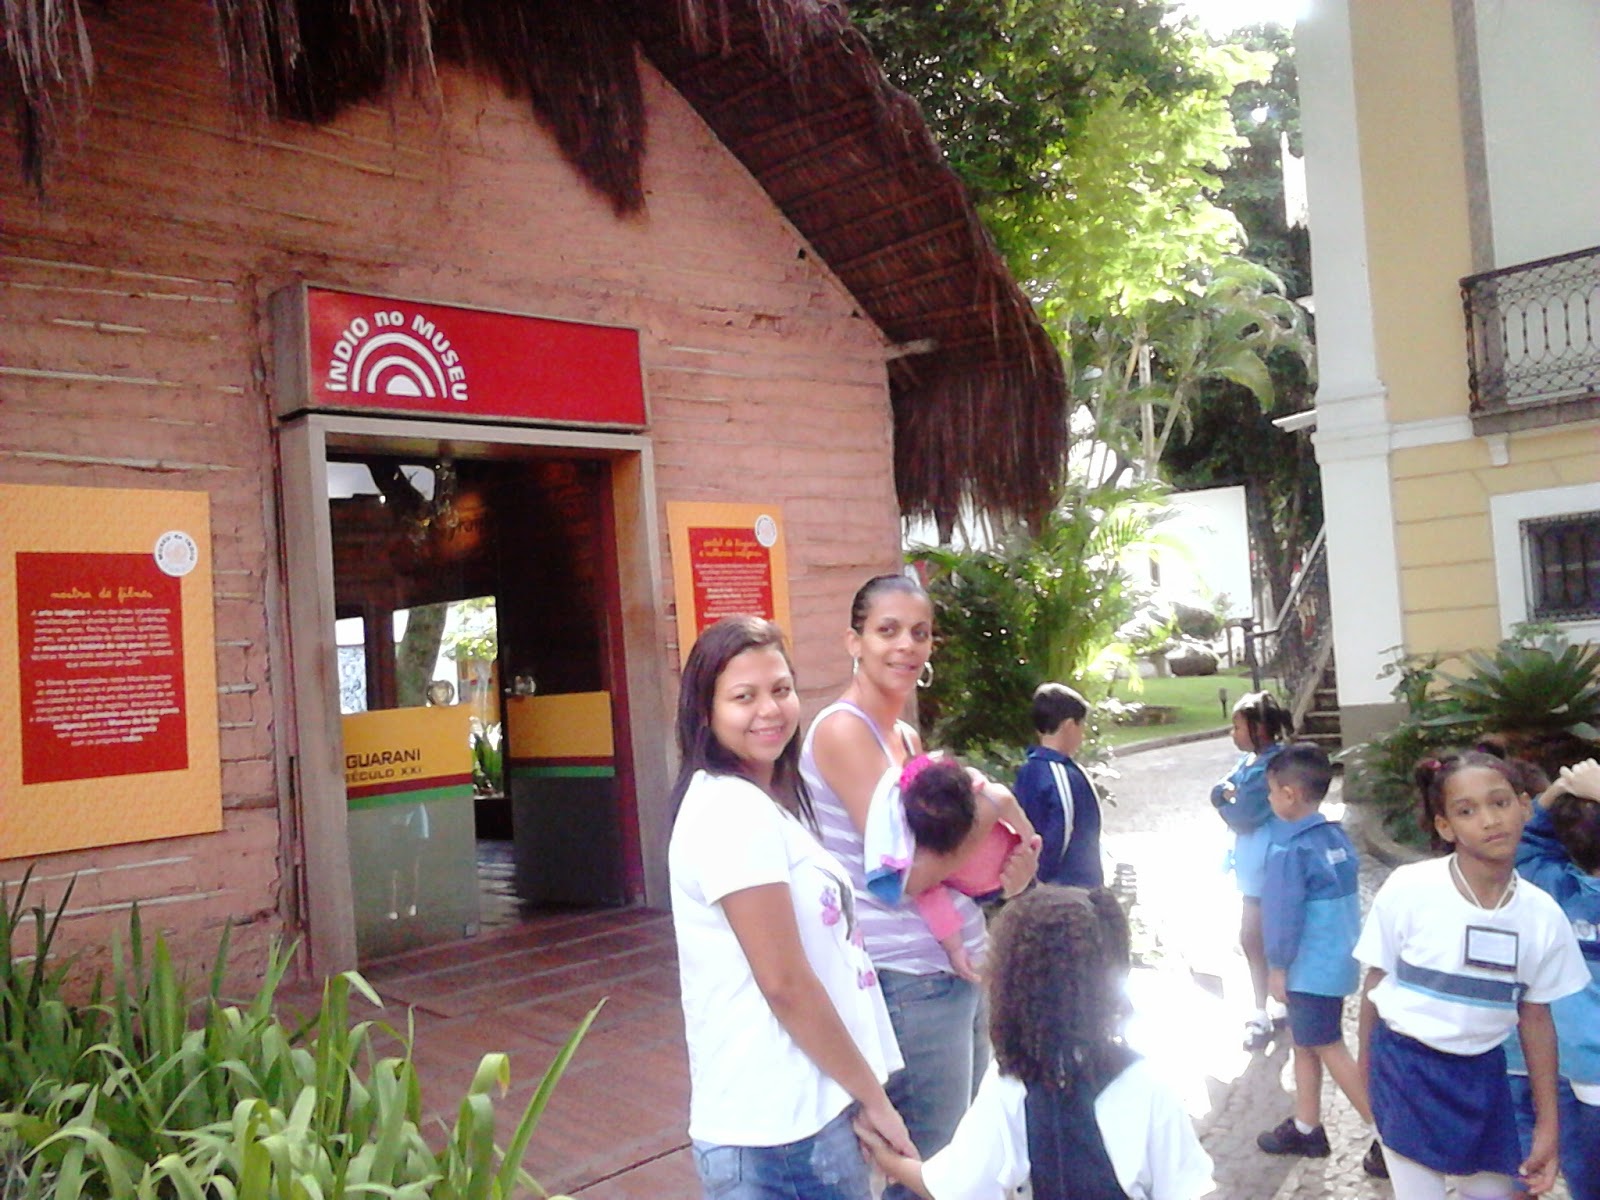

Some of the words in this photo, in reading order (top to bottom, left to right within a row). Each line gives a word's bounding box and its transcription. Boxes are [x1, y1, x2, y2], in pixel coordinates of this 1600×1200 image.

[325, 317, 370, 392] ÍNDIO
[374, 310, 405, 328] no
[411, 314, 469, 401] MUSEU
[345, 748, 421, 769] GUARANI
